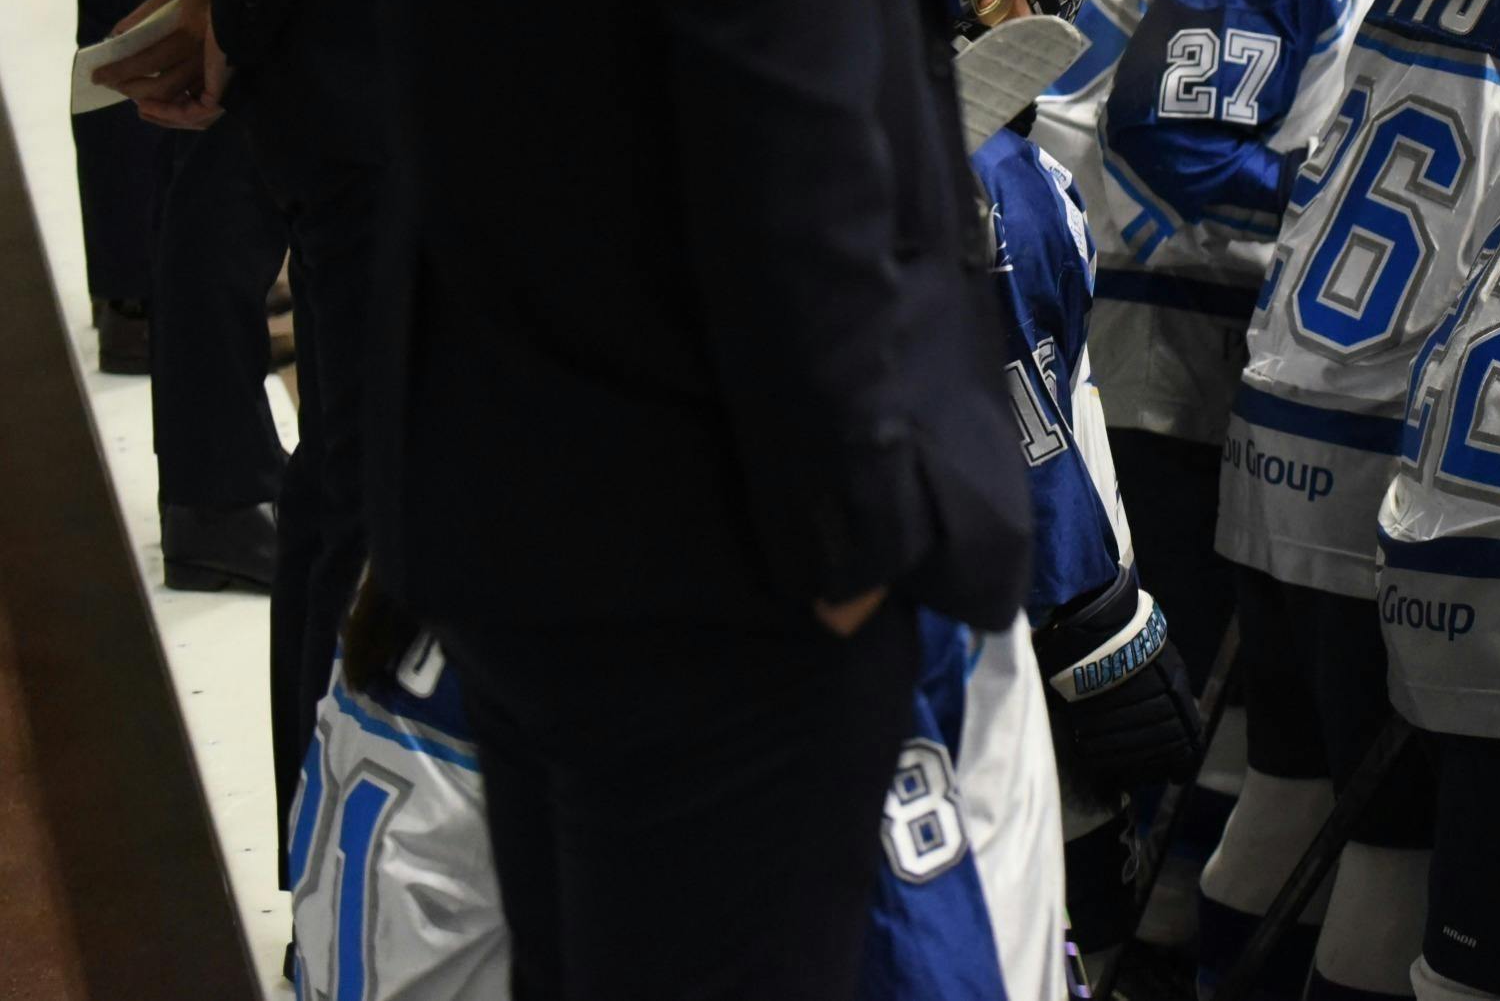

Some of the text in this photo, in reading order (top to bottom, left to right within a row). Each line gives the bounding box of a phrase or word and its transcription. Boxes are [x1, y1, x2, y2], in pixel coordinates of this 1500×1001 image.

[1157, 26, 1282, 126] 27
[1246, 439, 1334, 502] Group
[1383, 585, 1475, 641] Group
